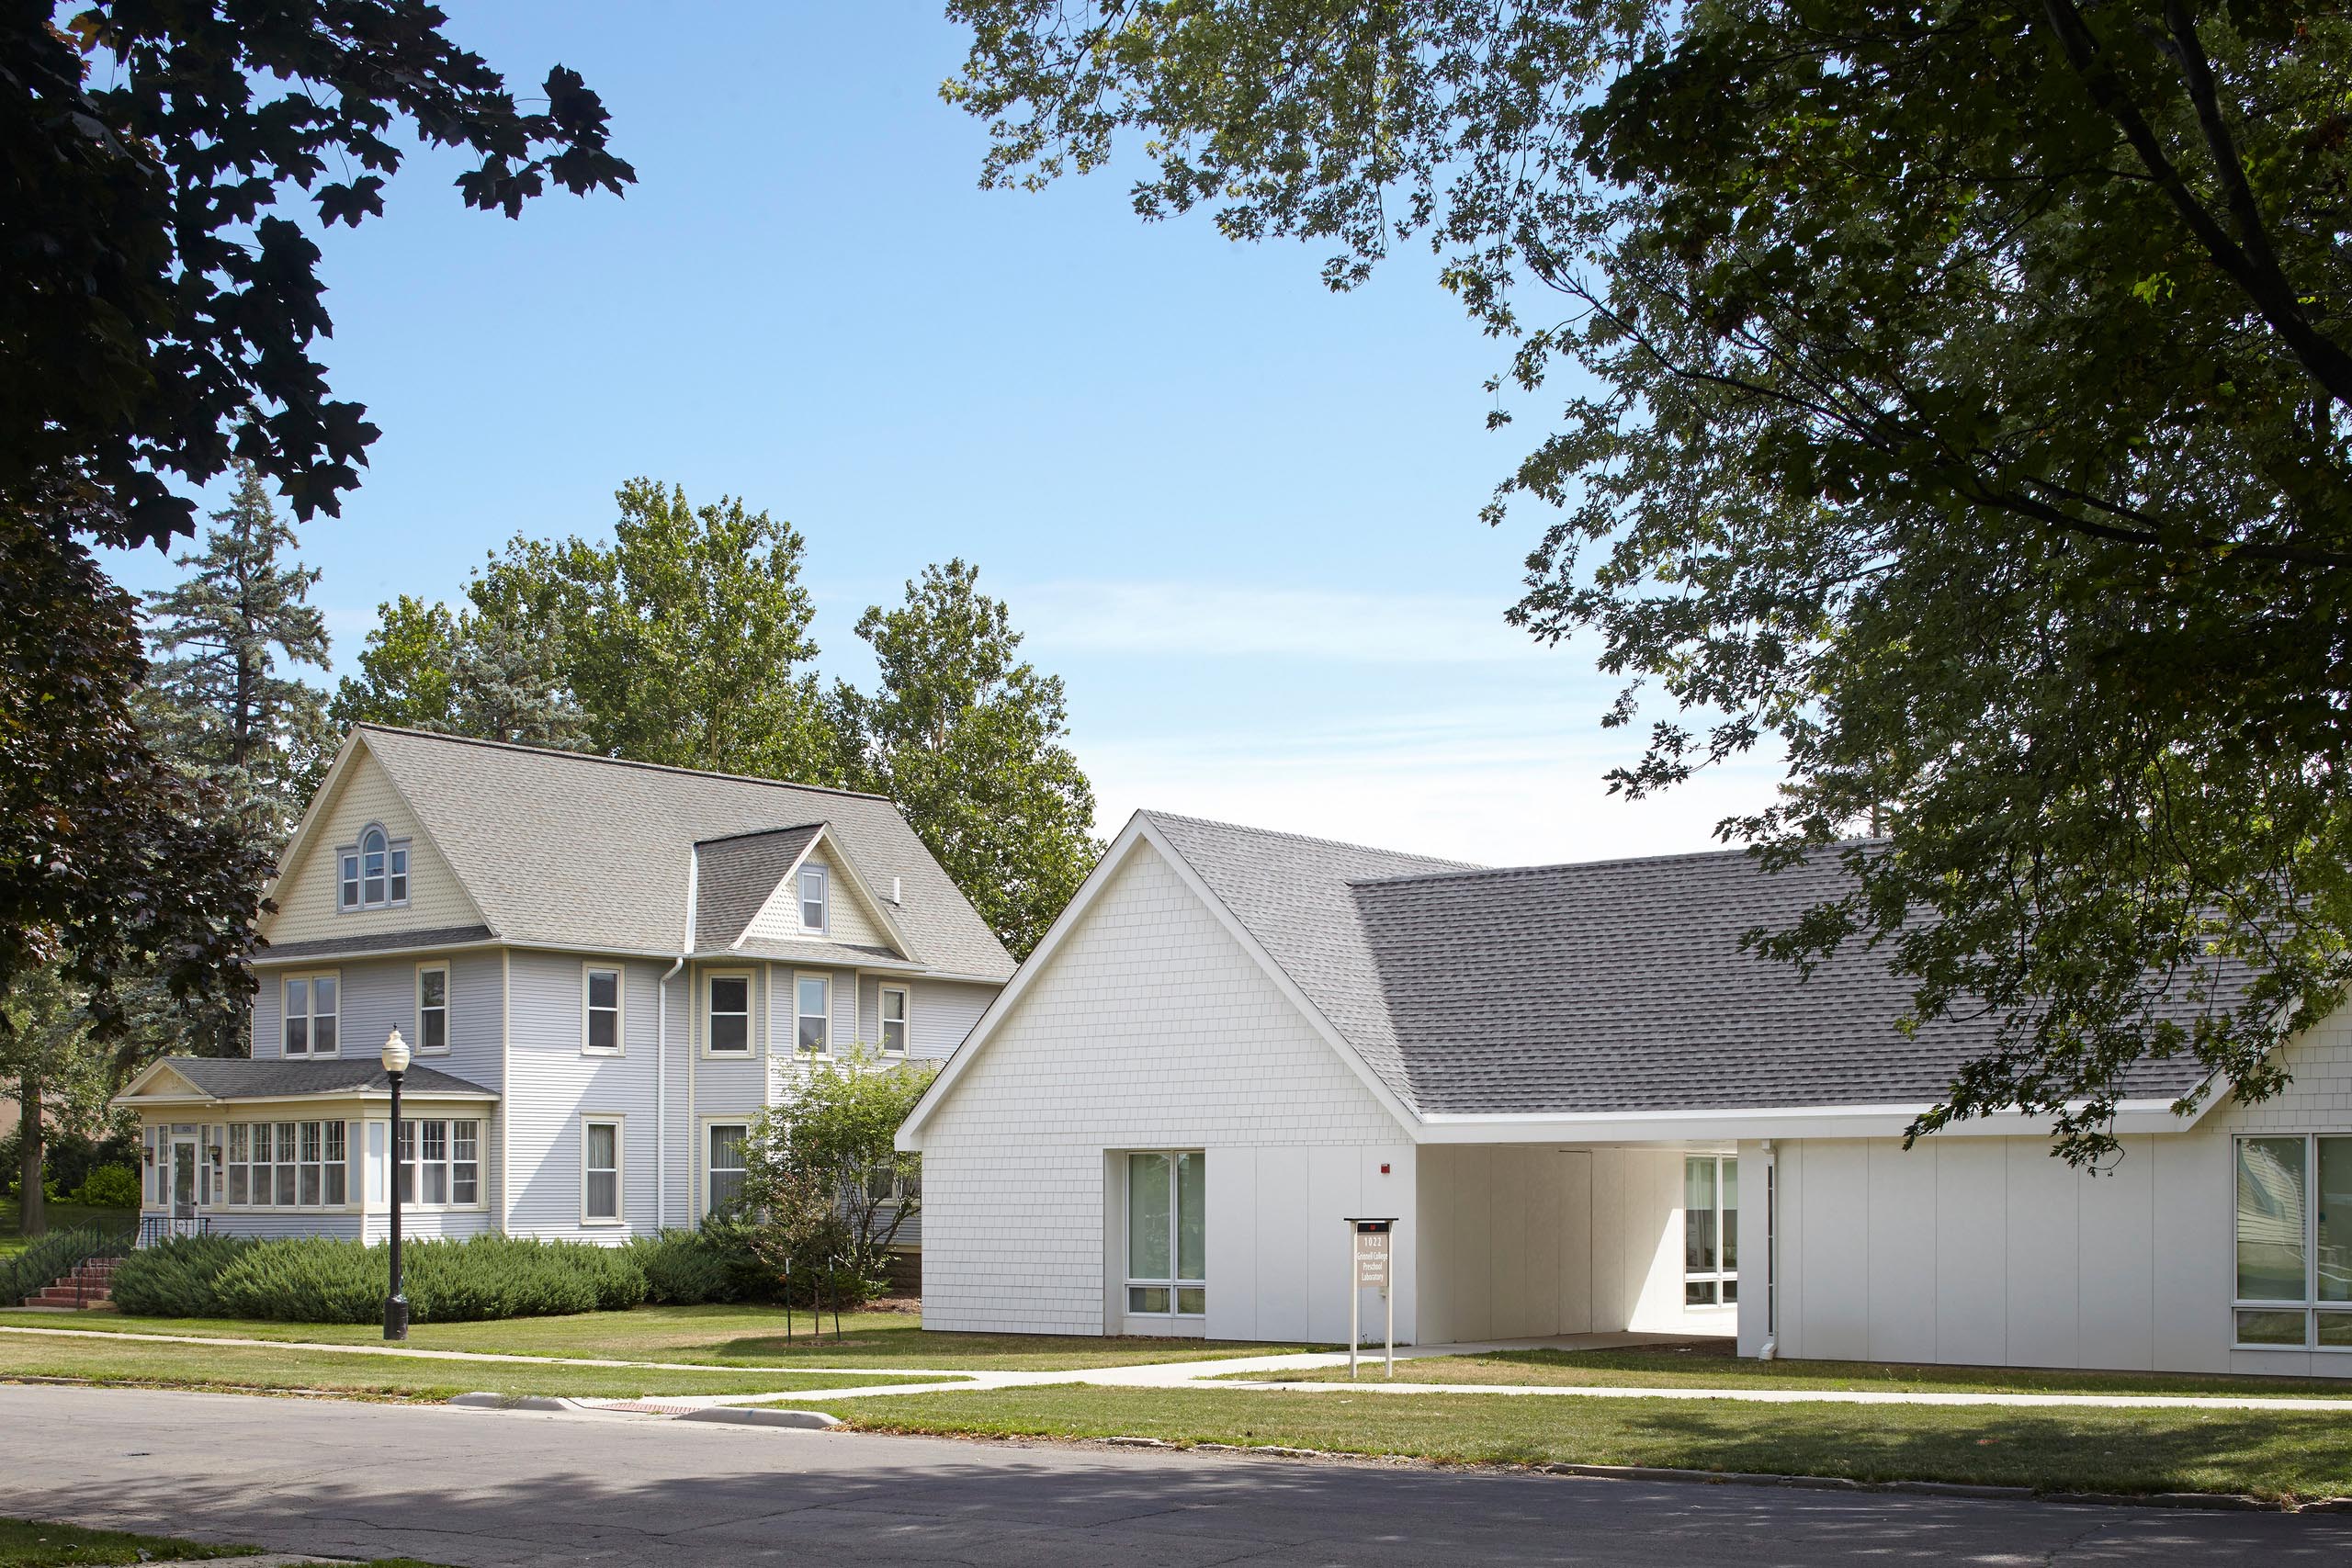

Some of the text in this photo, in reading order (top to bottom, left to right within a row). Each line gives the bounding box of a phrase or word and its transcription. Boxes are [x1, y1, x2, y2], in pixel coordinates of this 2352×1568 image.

[1364, 1236, 1382, 1247] 1022
[1373, 1251, 1388, 1261] College
[1363, 1261, 1383, 1270] Preschool
[1361, 1272, 1384, 1282] Laboratory
